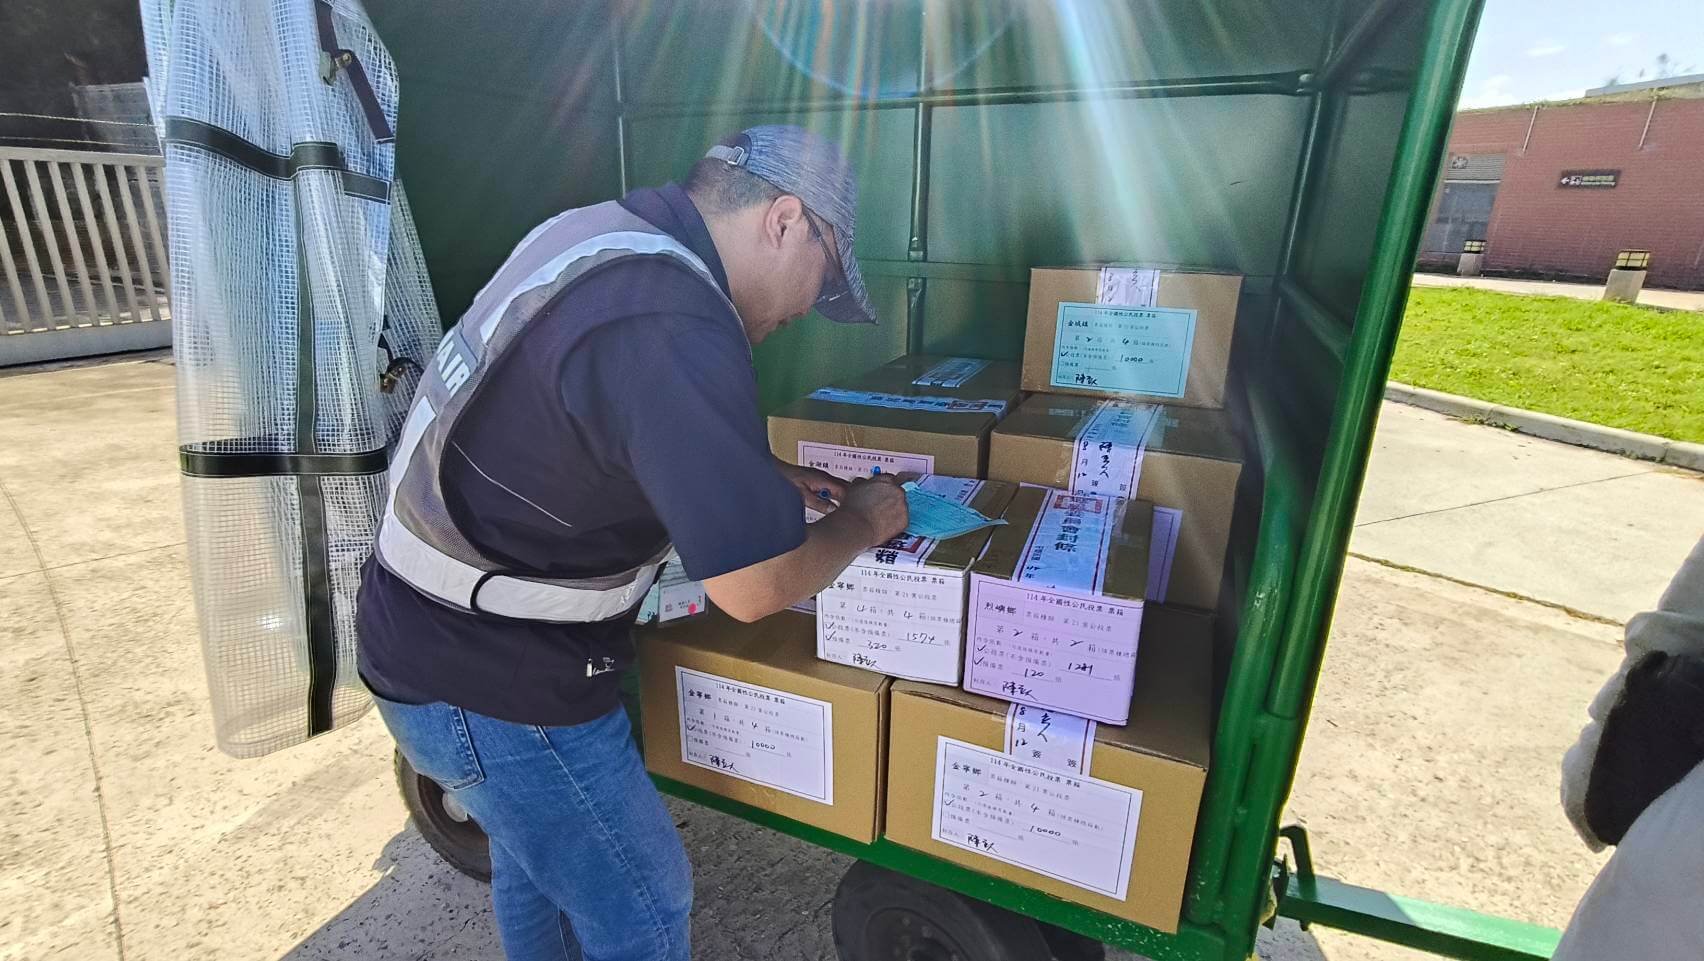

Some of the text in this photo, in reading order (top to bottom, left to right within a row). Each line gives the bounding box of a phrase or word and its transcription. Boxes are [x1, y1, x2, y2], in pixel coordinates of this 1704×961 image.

[1120, 354, 1143, 362] 10000
[1027, 593, 1123, 616] 114年全國性公民投票 票箱
[1024, 668, 1045, 678] 120
[1016, 723, 1026, 733] 月
[1014, 739, 1028, 748] 12
[1031, 803, 1040, 813] 4
[1029, 825, 1061, 837] 10000
